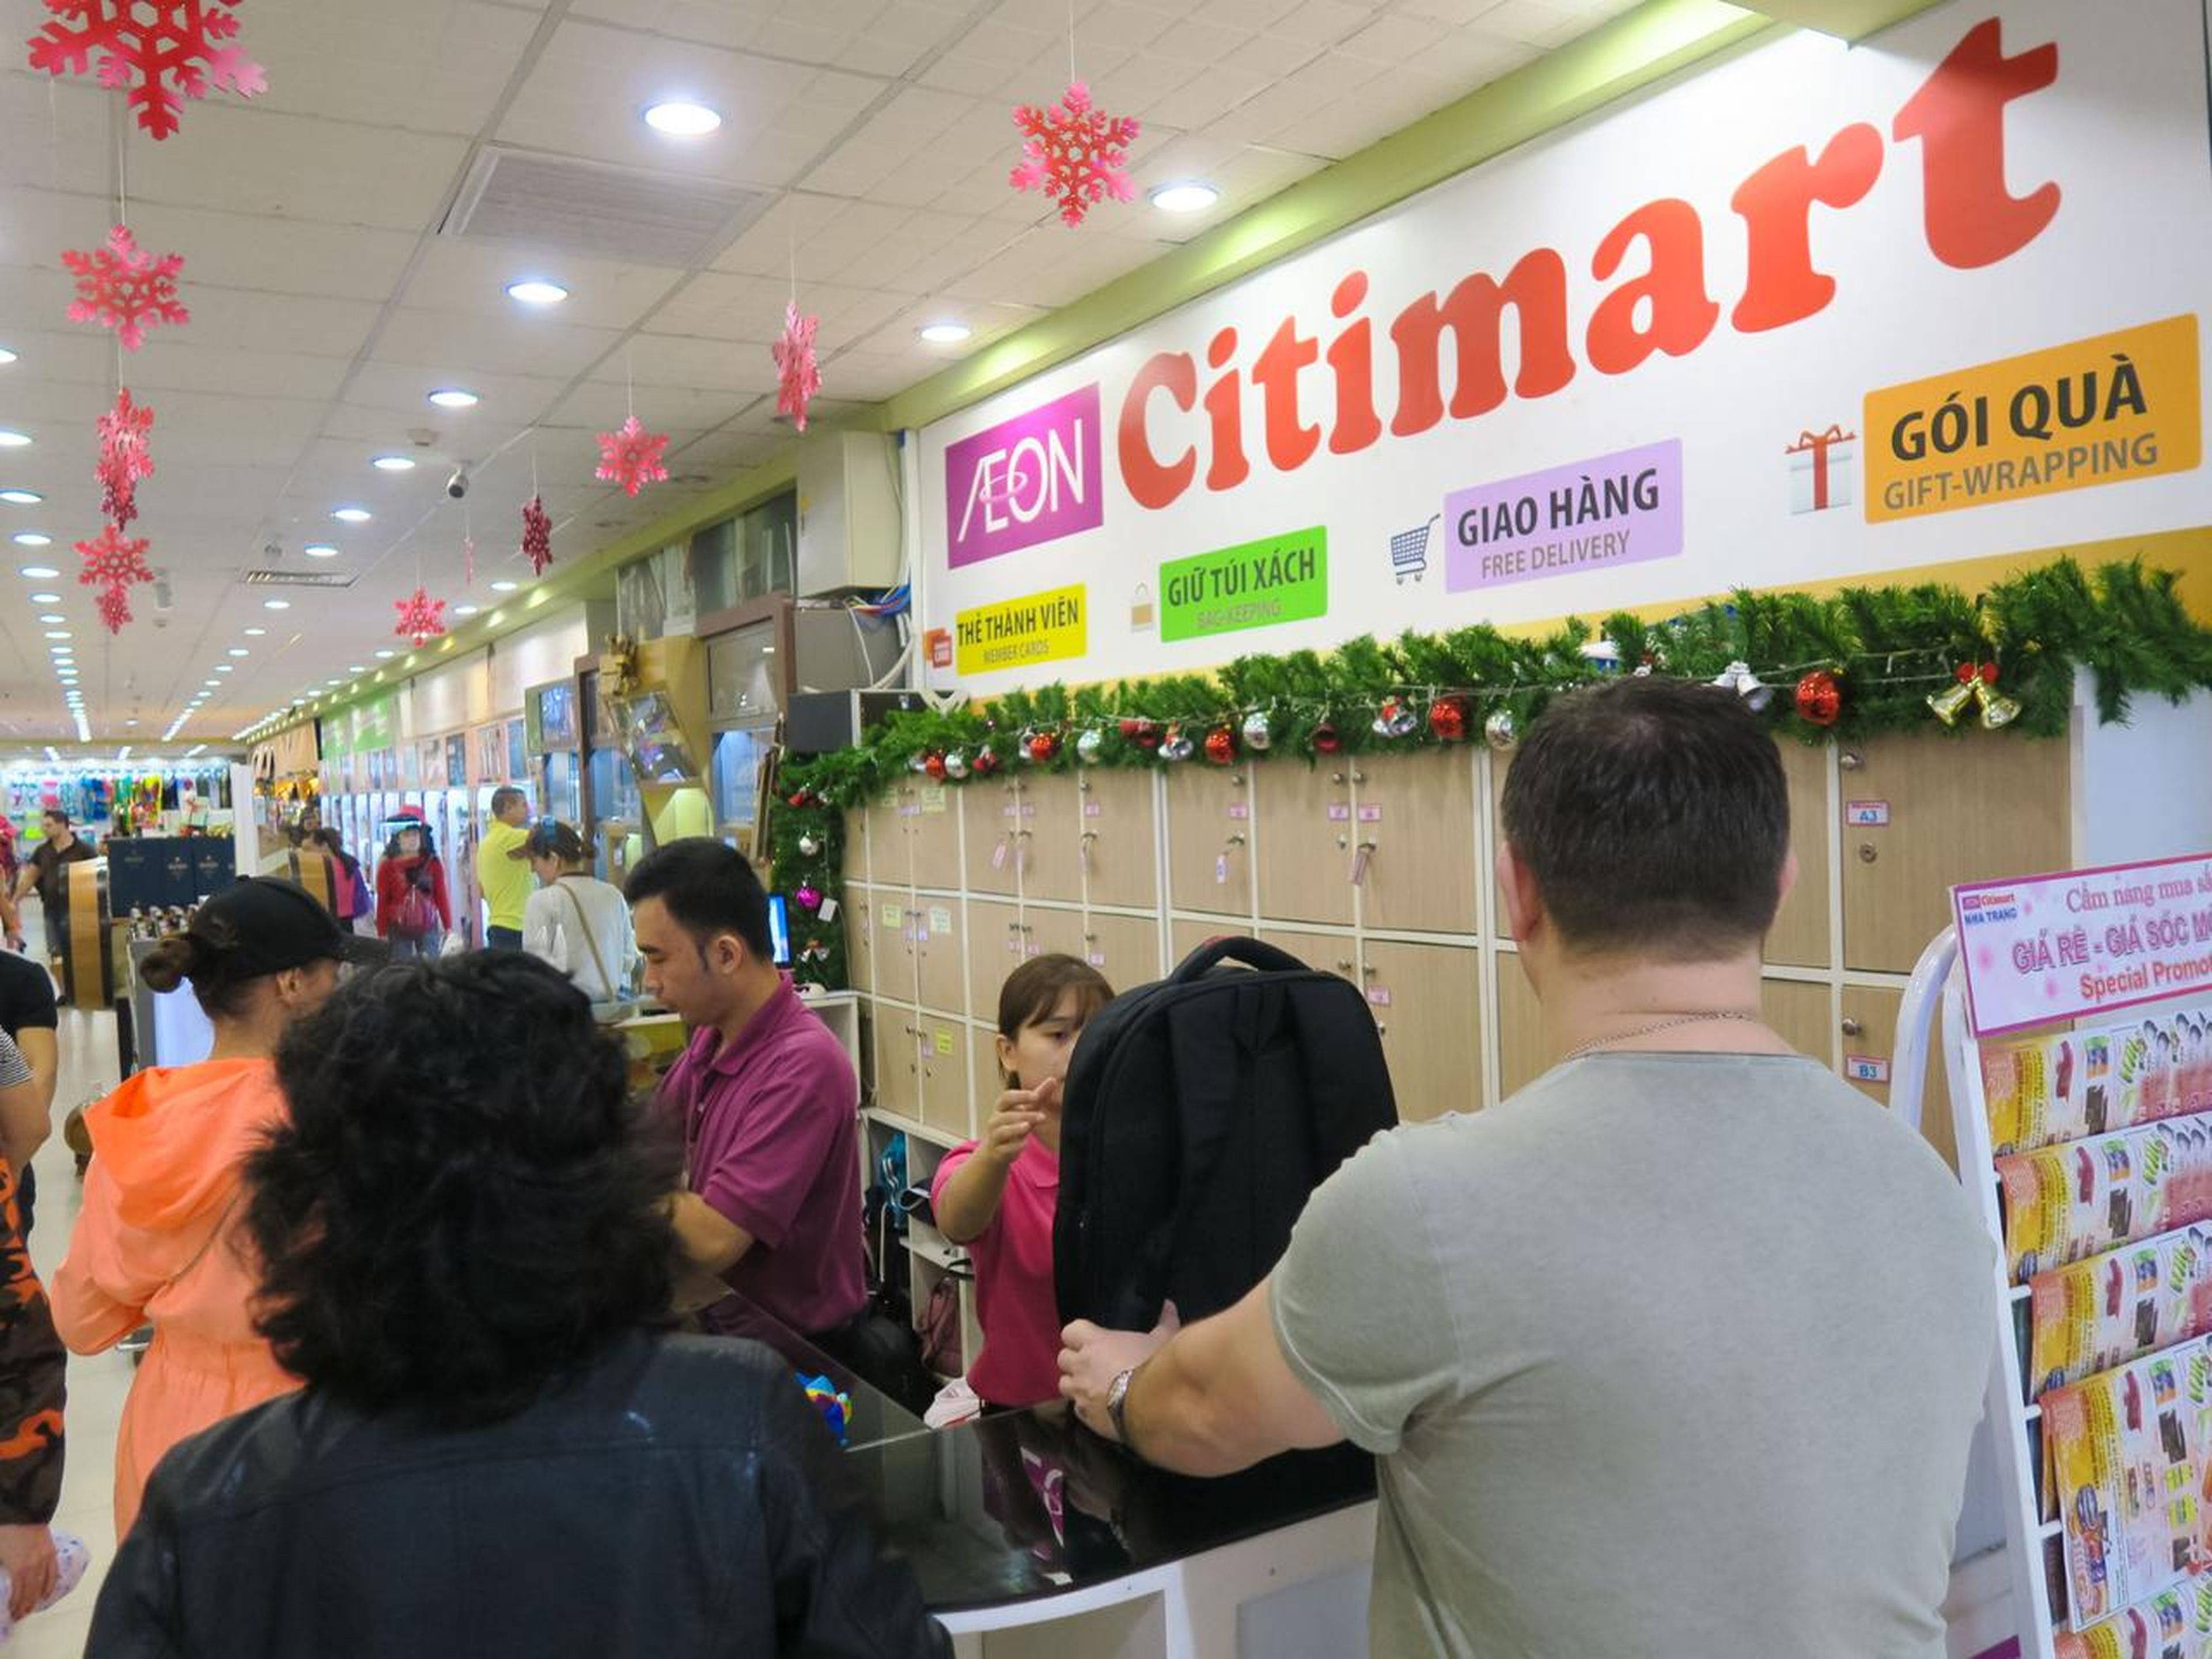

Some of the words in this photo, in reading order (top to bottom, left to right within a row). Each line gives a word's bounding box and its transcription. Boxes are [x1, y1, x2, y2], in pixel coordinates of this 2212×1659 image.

[1118, 15, 2061, 510] Citimart
[1891, 391, 1988, 461] GÓI
[2009, 353, 2147, 440] QUÀ
[1884, 432, 2158, 510] GIFT-WRAPPING
[1457, 495, 1538, 547] GIAO
[1550, 468, 1660, 529] HÀNG
[1168, 566, 1206, 607] GIỮ
[1210, 558, 1246, 598] TÚI
[1252, 548, 1315, 590] XÁCH
[1482, 550, 1526, 579] FREE
[1532, 529, 1631, 570] DELIVERY
[985, 608, 1036, 641] THÀNH
[1859, 809, 1877, 822] A3
[2080, 962, 2149, 1003] Special
[1859, 1064, 1877, 1079] B3
